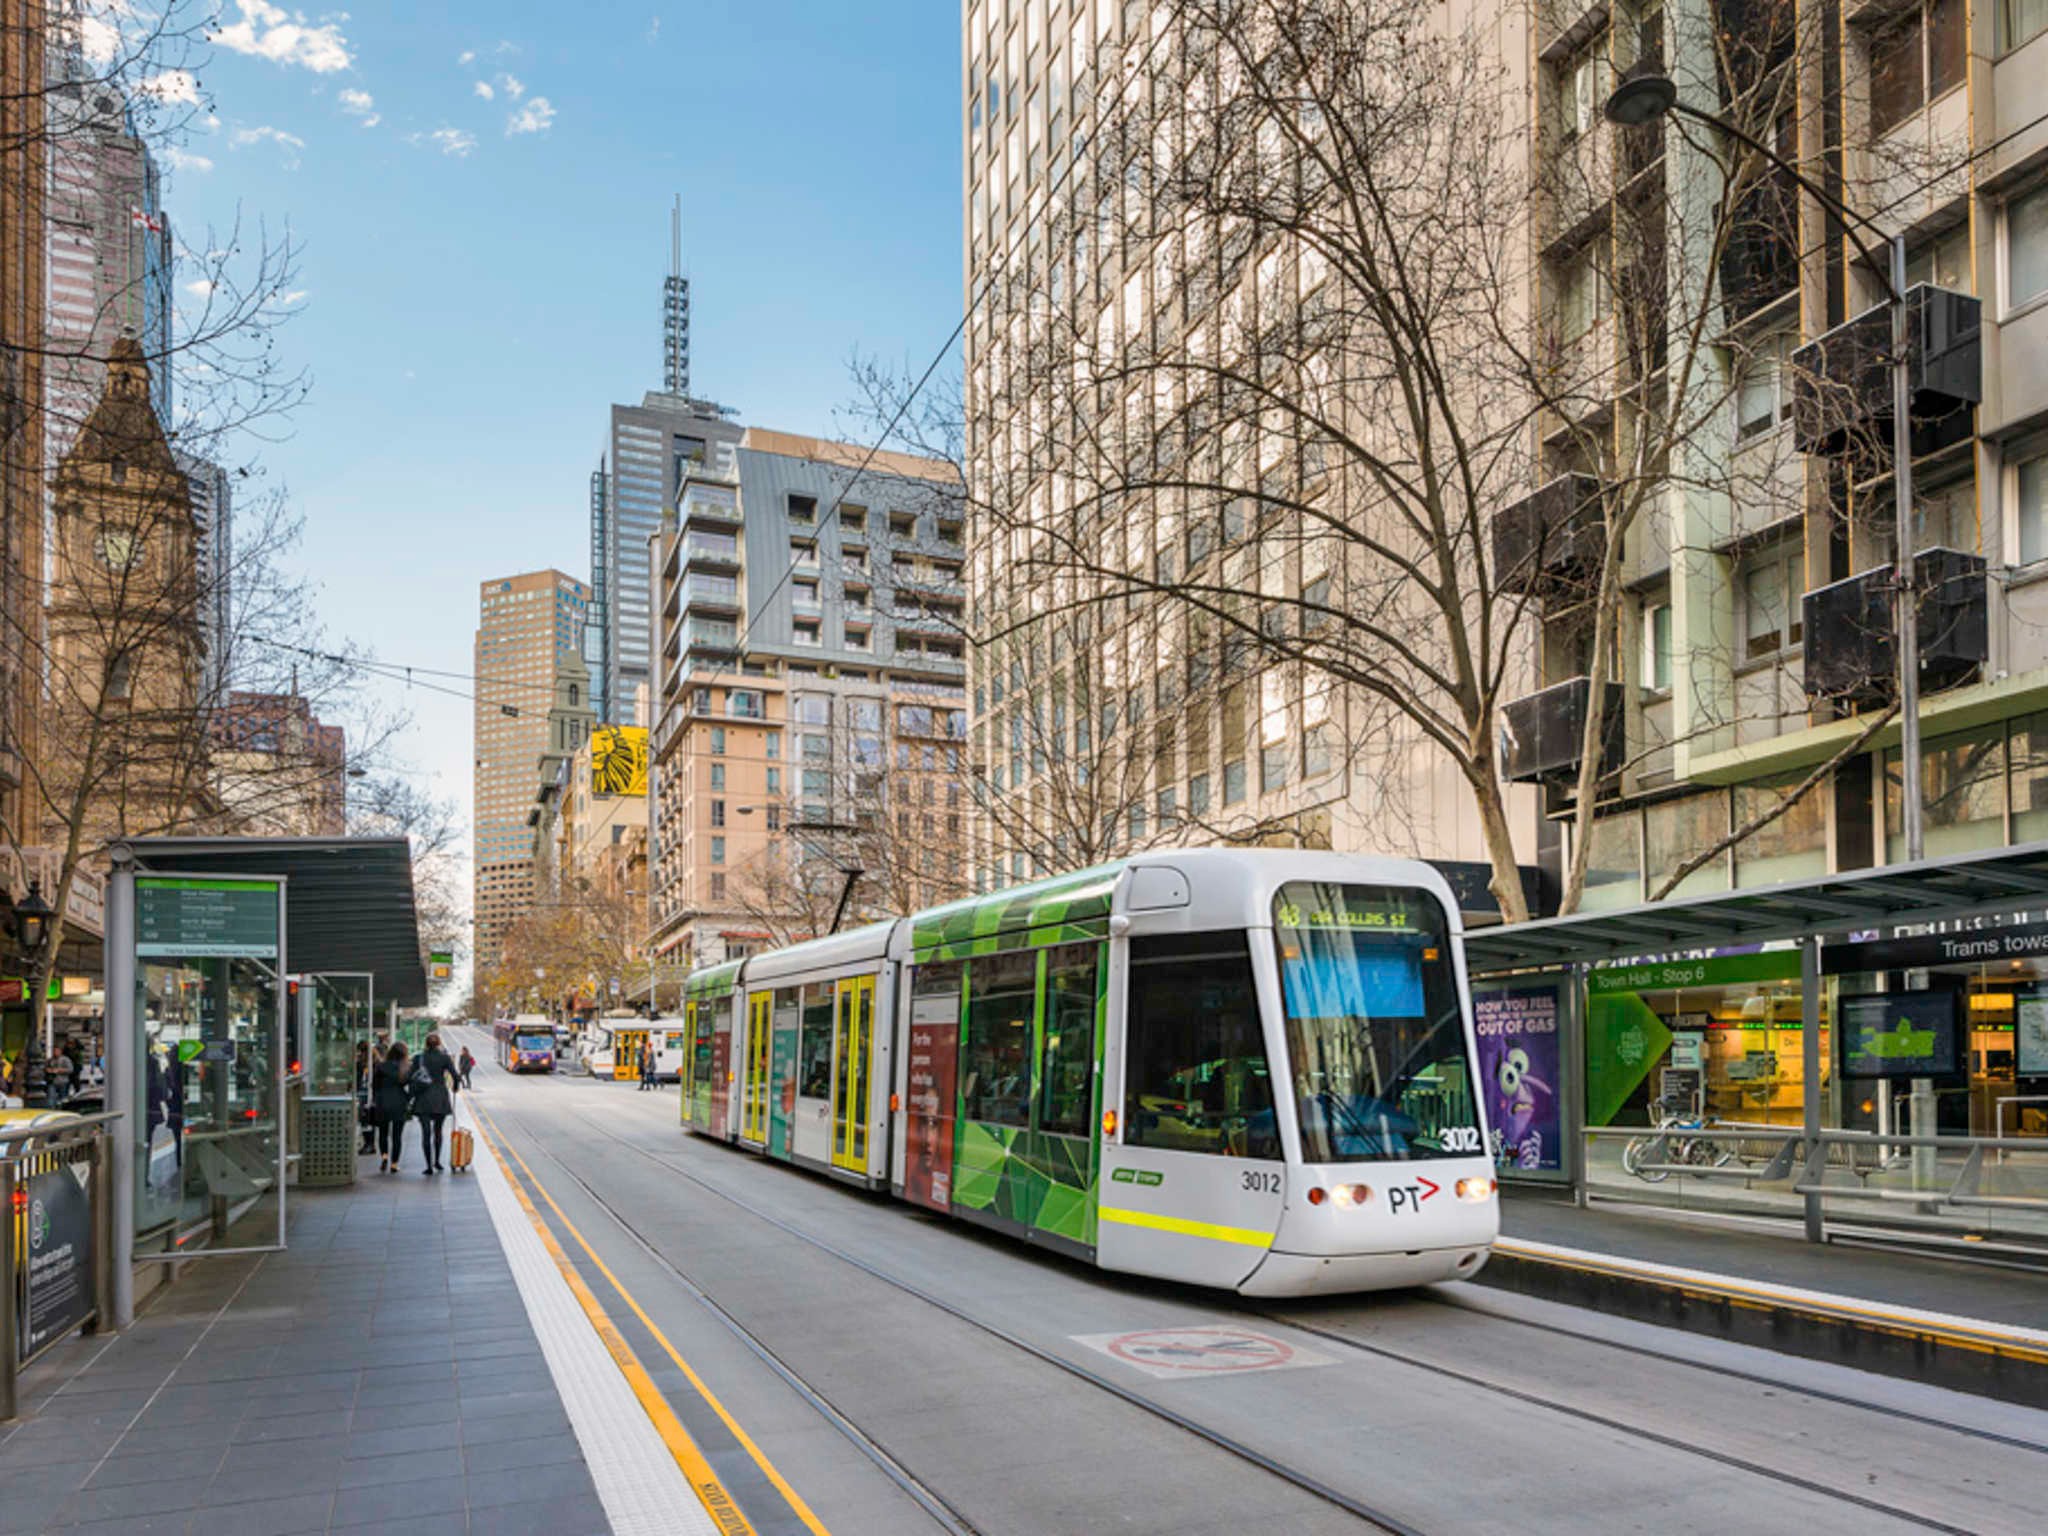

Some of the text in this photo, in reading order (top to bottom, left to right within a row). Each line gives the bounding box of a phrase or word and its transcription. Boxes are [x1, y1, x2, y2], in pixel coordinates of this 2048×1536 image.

[1941, 939, 2000, 958] Trams
[1597, 975, 1628, 989] Town
[1628, 971, 1652, 986] Hall
[1662, 968, 1693, 985] Stop
[1695, 965, 1705, 981] 6
[1475, 1000, 1504, 1013] HOW
[1504, 998, 1528, 1011] YOU
[1477, 1018, 1555, 1036] OUT OF GAS
[1440, 1127, 1481, 1151] 3012
[1241, 1171, 1281, 1194] 3012
